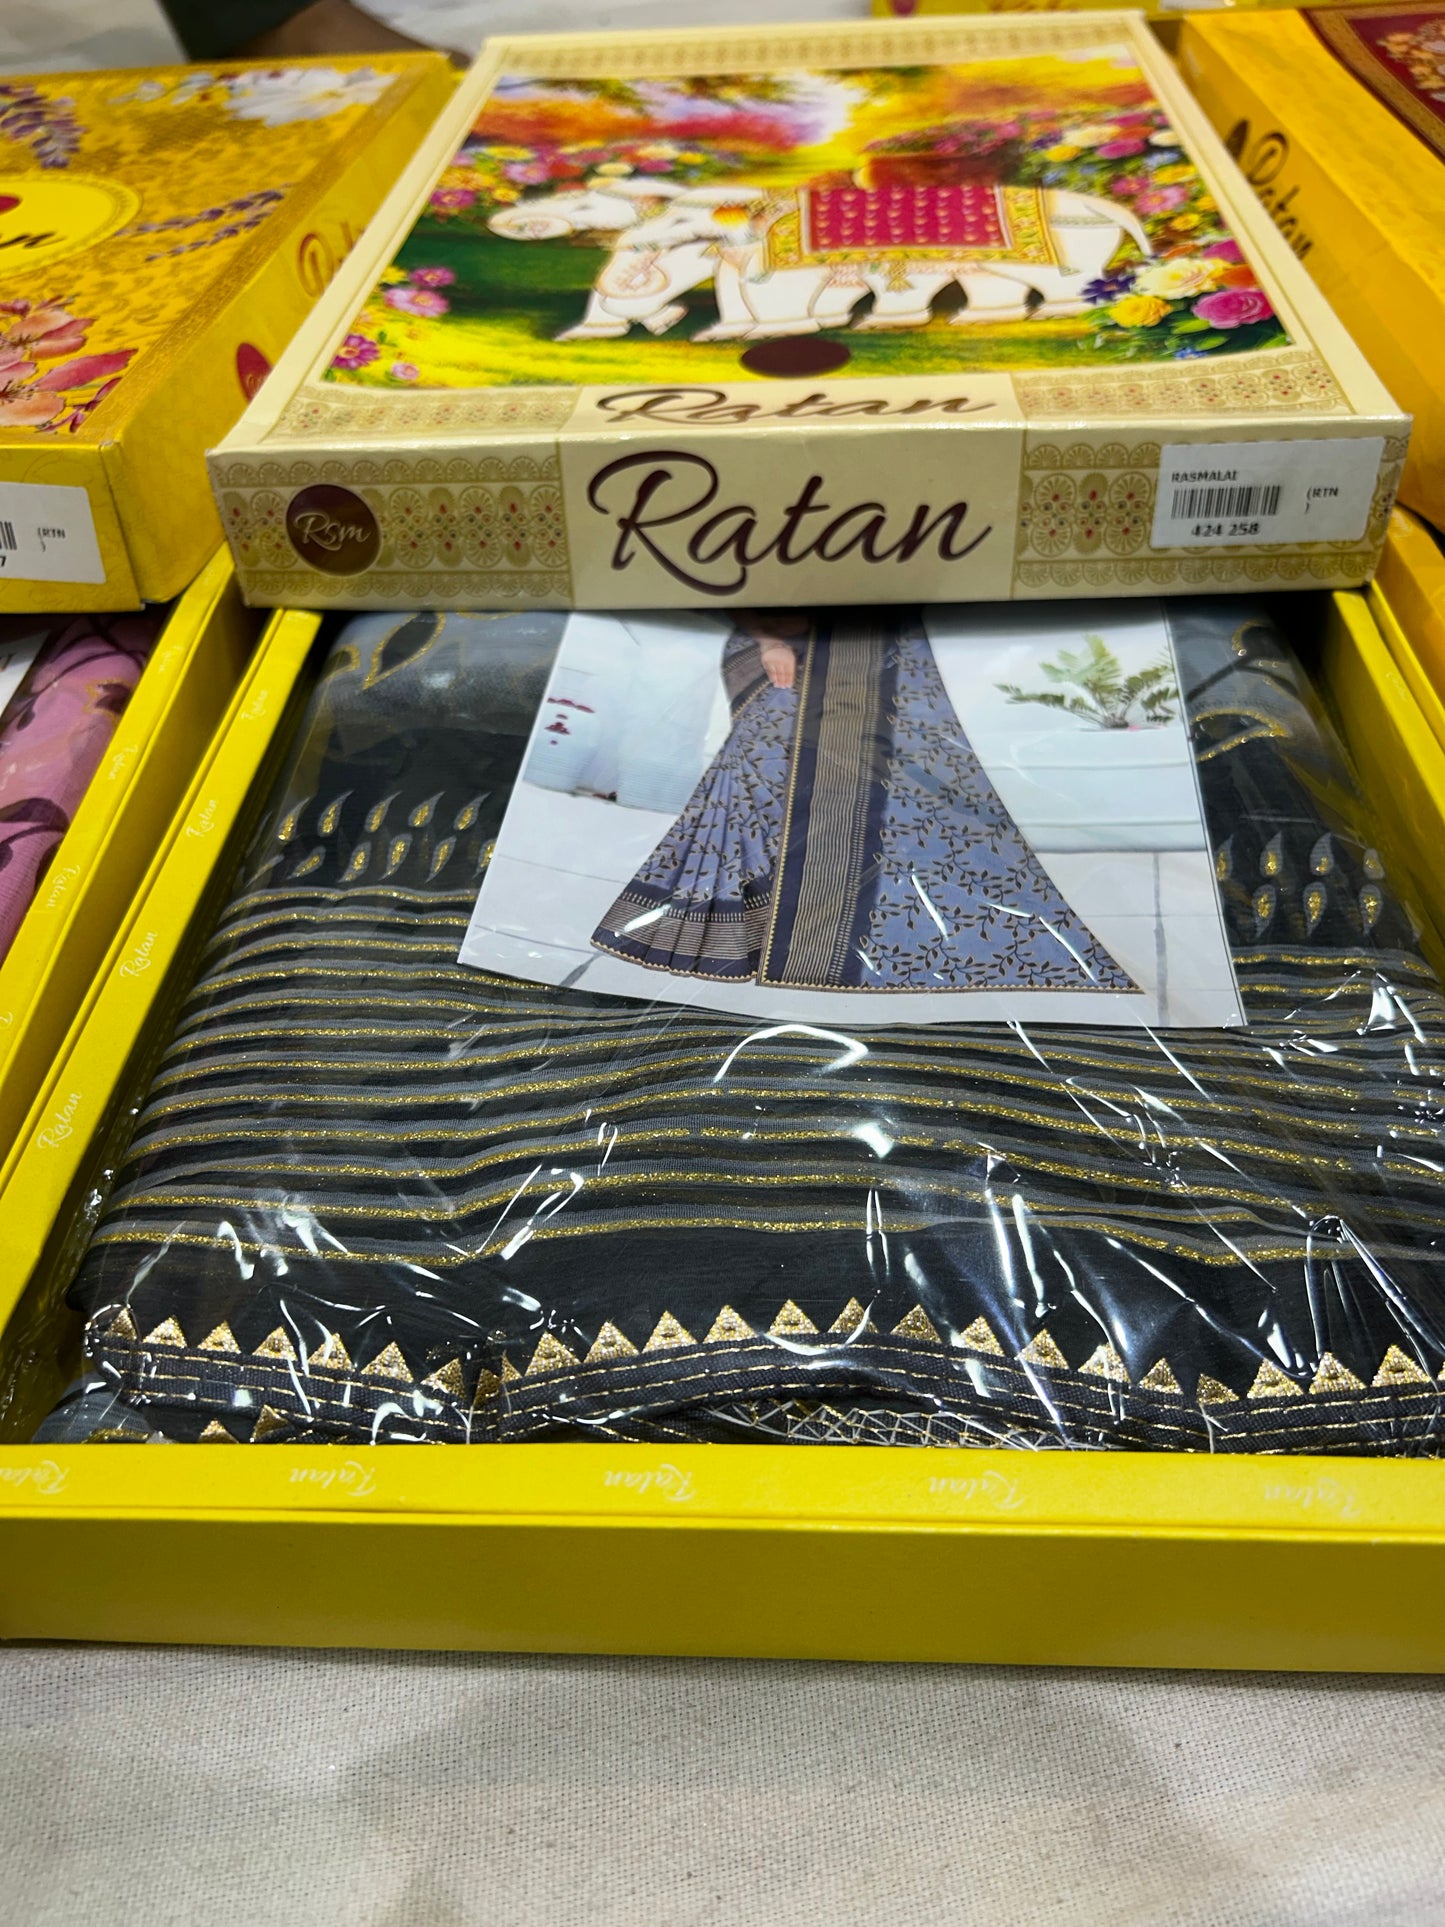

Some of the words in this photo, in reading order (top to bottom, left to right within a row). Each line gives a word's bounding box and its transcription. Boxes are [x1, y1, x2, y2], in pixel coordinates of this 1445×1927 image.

[596, 387, 997, 425] Ratan
[1171, 469, 1238, 483] RASMALAI
[1306, 486, 1339, 499] (RTN
[294, 512, 372, 551] Rsm
[587, 450, 993, 597] Ratan
[1191, 523, 1224, 537] 424
[1228, 522, 1260, 536] 258
[119, 930, 158, 978] Ratan
[37, 1091, 83, 1150] Ratan
[289, 1460, 377, 1497] Ratan
[602, 1463, 698, 1502] Ratan
[928, 1470, 1026, 1510] Ratan
